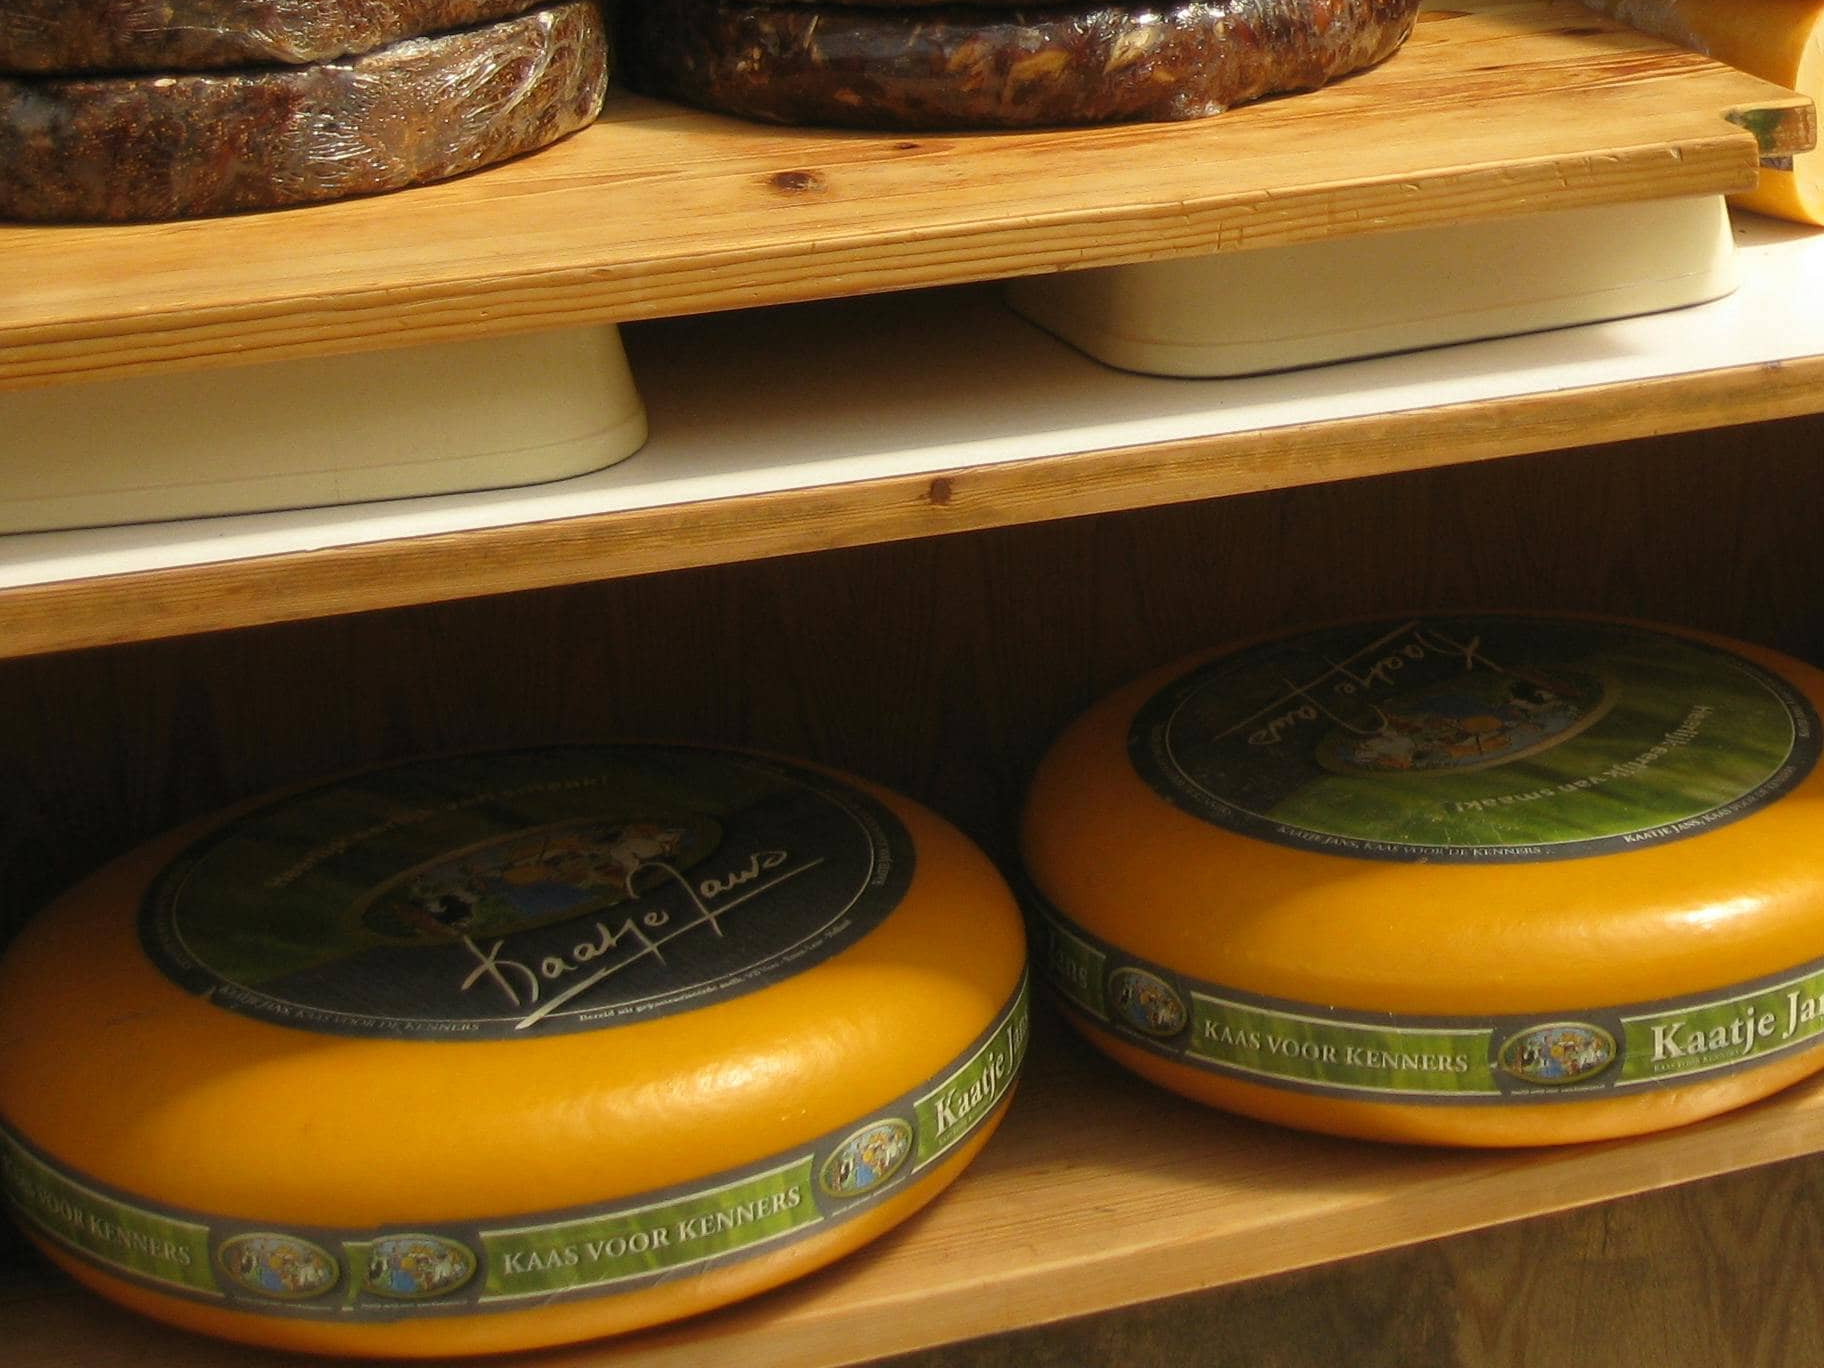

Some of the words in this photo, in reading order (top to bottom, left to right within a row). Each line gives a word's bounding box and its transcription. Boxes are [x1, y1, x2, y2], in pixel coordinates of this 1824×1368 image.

[1205, 1019, 1261, 1050] KAAS
[1267, 1035, 1337, 1064] VOOR
[1346, 1046, 1468, 1072] KENNERS
[1650, 1006, 1776, 1063] Kaatje
[934, 1052, 1004, 1138] Kaatje
[503, 1244, 579, 1275] KAAS
[585, 1226, 671, 1262] VOOR
[678, 1184, 802, 1241] KENNERS
